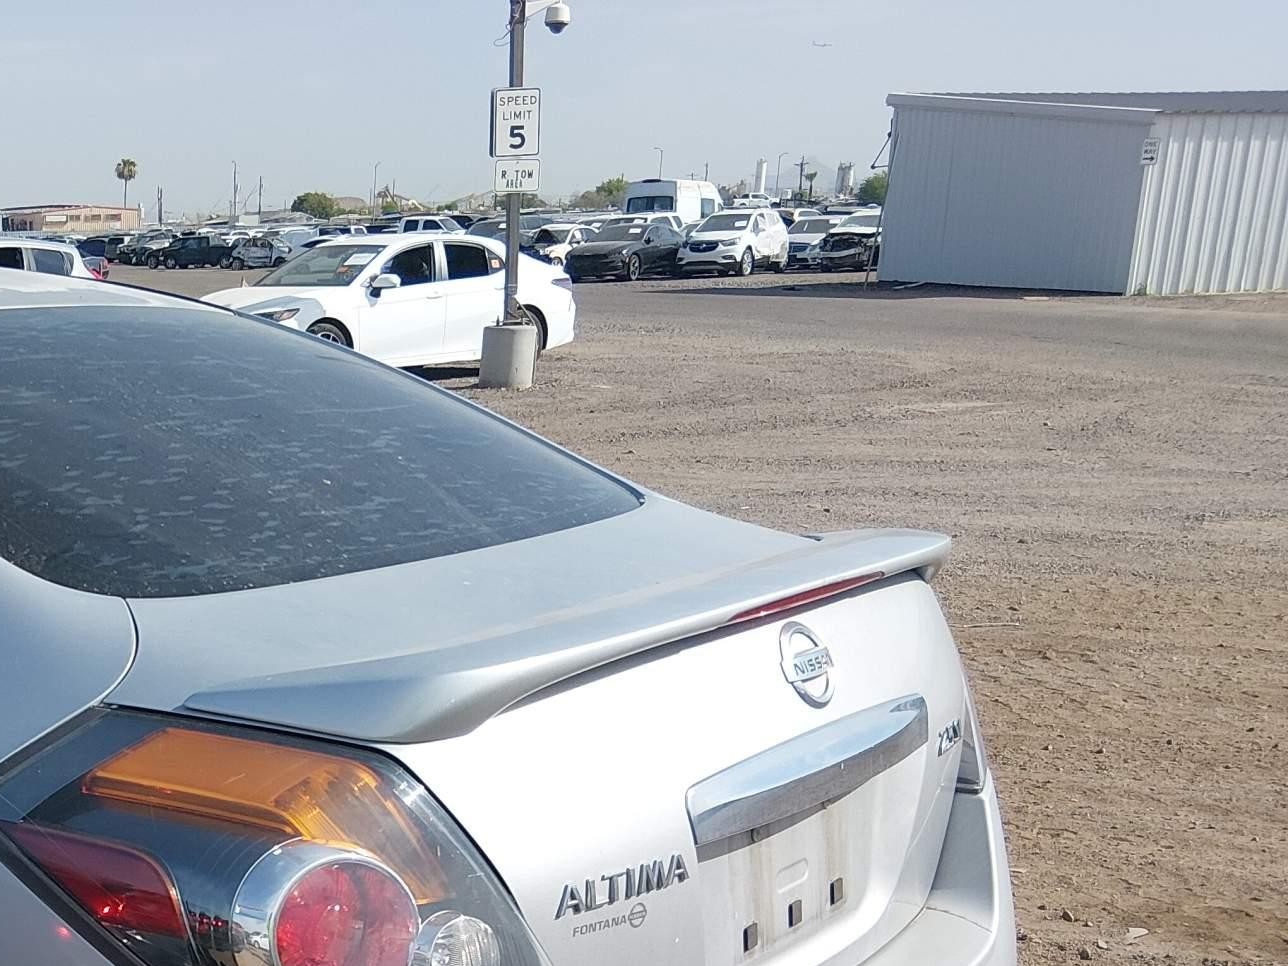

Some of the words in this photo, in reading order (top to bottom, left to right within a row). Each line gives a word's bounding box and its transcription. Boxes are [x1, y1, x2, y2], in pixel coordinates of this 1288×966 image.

[499, 95, 537, 107] SPEED
[502, 110, 532, 121] LIMIT
[509, 125, 526, 150] 5
[514, 169, 534, 181] TOW
[505, 179, 523, 189] AREA
[554, 854, 690, 920] ALTIMA
[572, 914, 627, 938] FONTANA
